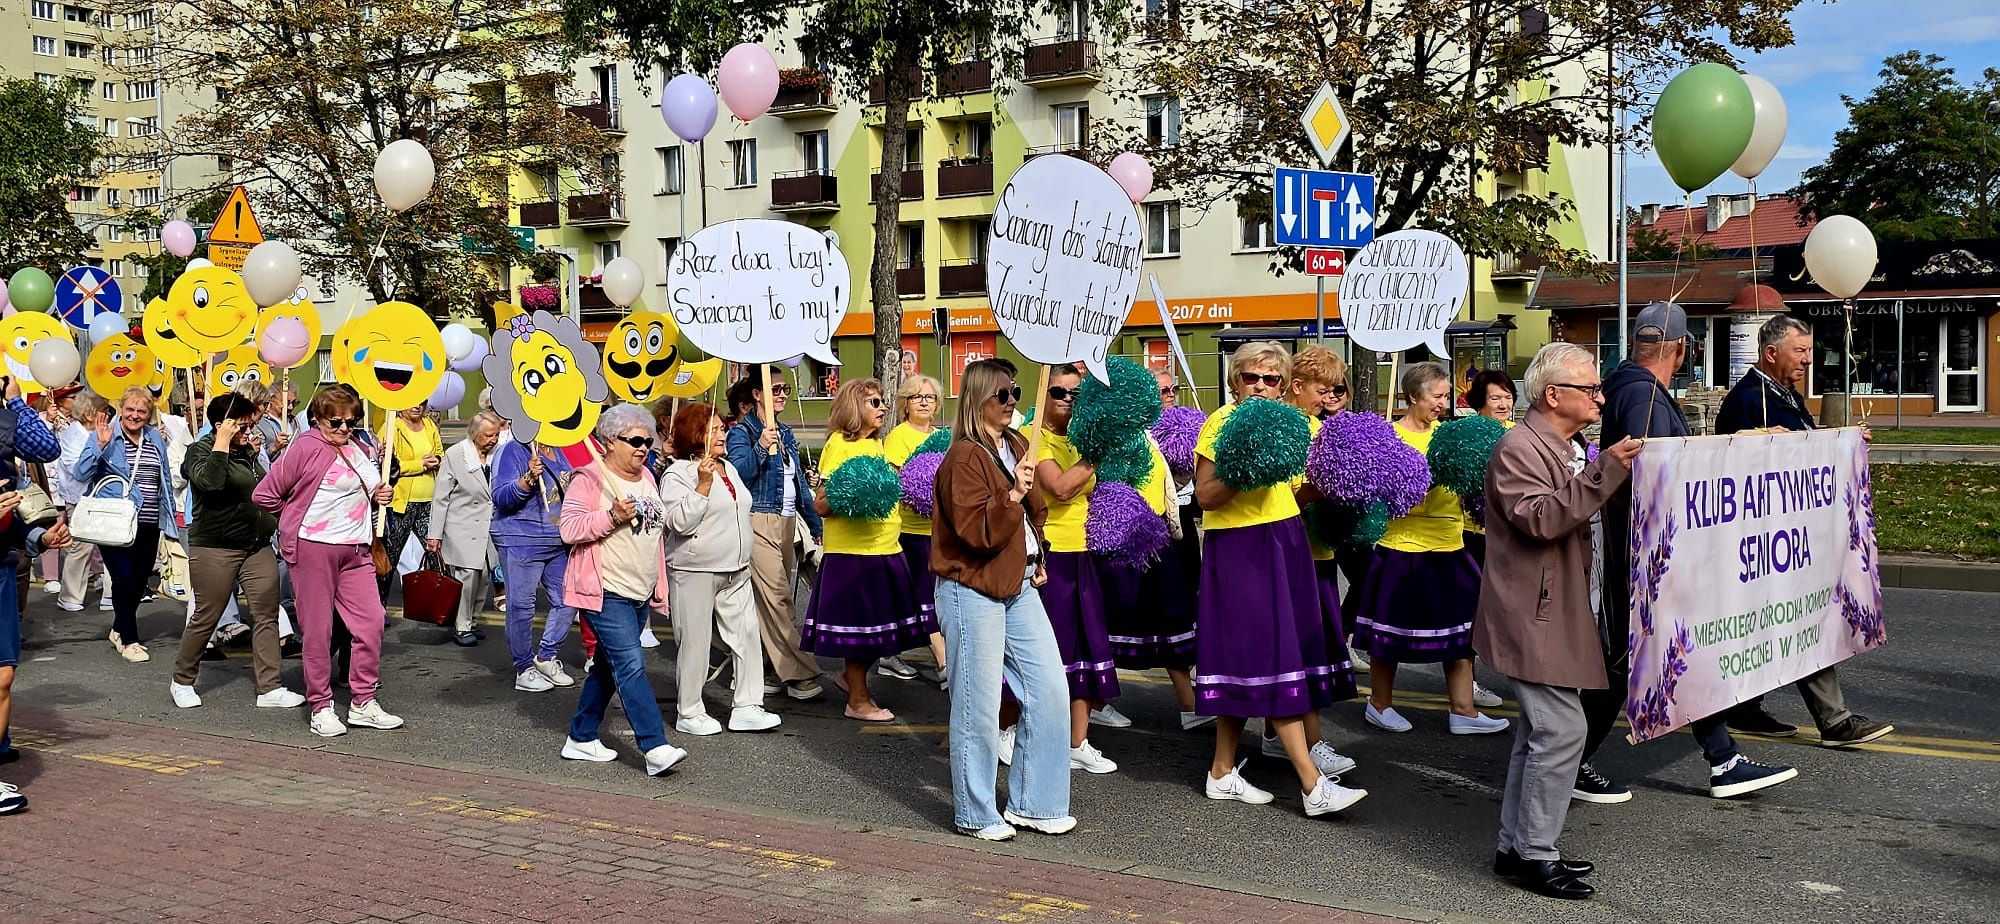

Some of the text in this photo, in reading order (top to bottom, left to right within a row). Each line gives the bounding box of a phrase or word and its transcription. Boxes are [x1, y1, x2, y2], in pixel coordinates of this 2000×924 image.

[993, 183, 1054, 273] Seniorzy
[1062, 200, 1092, 259] dziś
[784, 232, 832, 287] trzy!
[1312, 255, 1325, 270] 60
[1360, 239, 1453, 271] SENIORZY MAJĄ
[673, 285, 839, 345] Seniorzy to my!
[1208, 302, 1232, 318] dni
[1368, 300, 1403, 331] DZIEŃ
[1406, 303, 1413, 331] I
[1808, 304, 1895, 316] OBRCZKI
[1685, 476, 1737, 530] KLUB
[1739, 525, 1811, 584] SENIORA
[1694, 586, 1834, 649] MIEJSKIEGO OŚRODKA POMOCY
[1779, 635, 1793, 659] W
